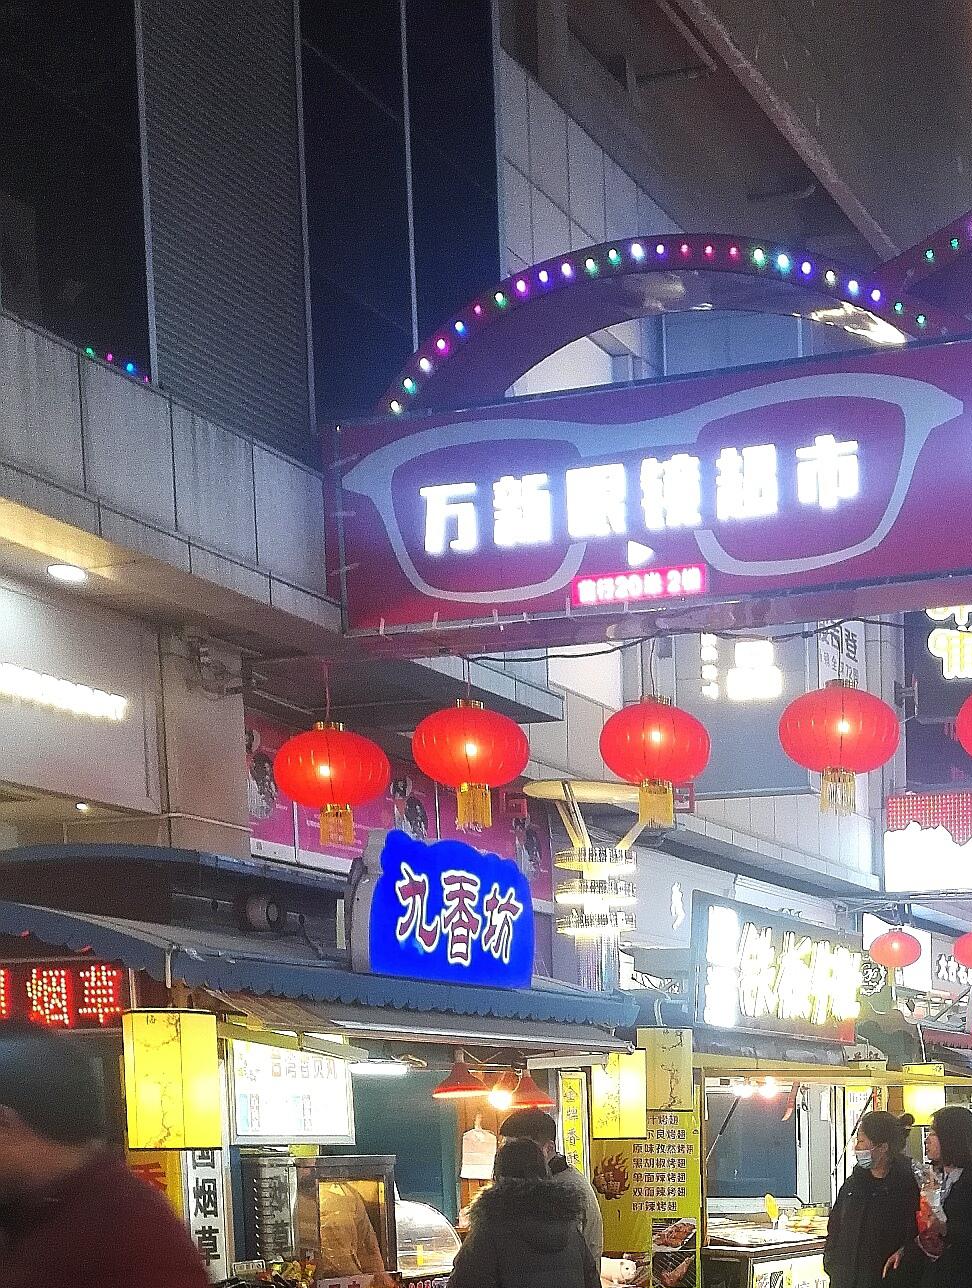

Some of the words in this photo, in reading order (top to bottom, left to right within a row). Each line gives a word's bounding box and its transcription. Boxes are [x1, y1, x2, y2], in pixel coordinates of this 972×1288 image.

[419, 435, 862, 556] 万新眼镜超市
[395, 862, 521, 967] 九香坊
[0, 965, 121, 1024] 烟草
